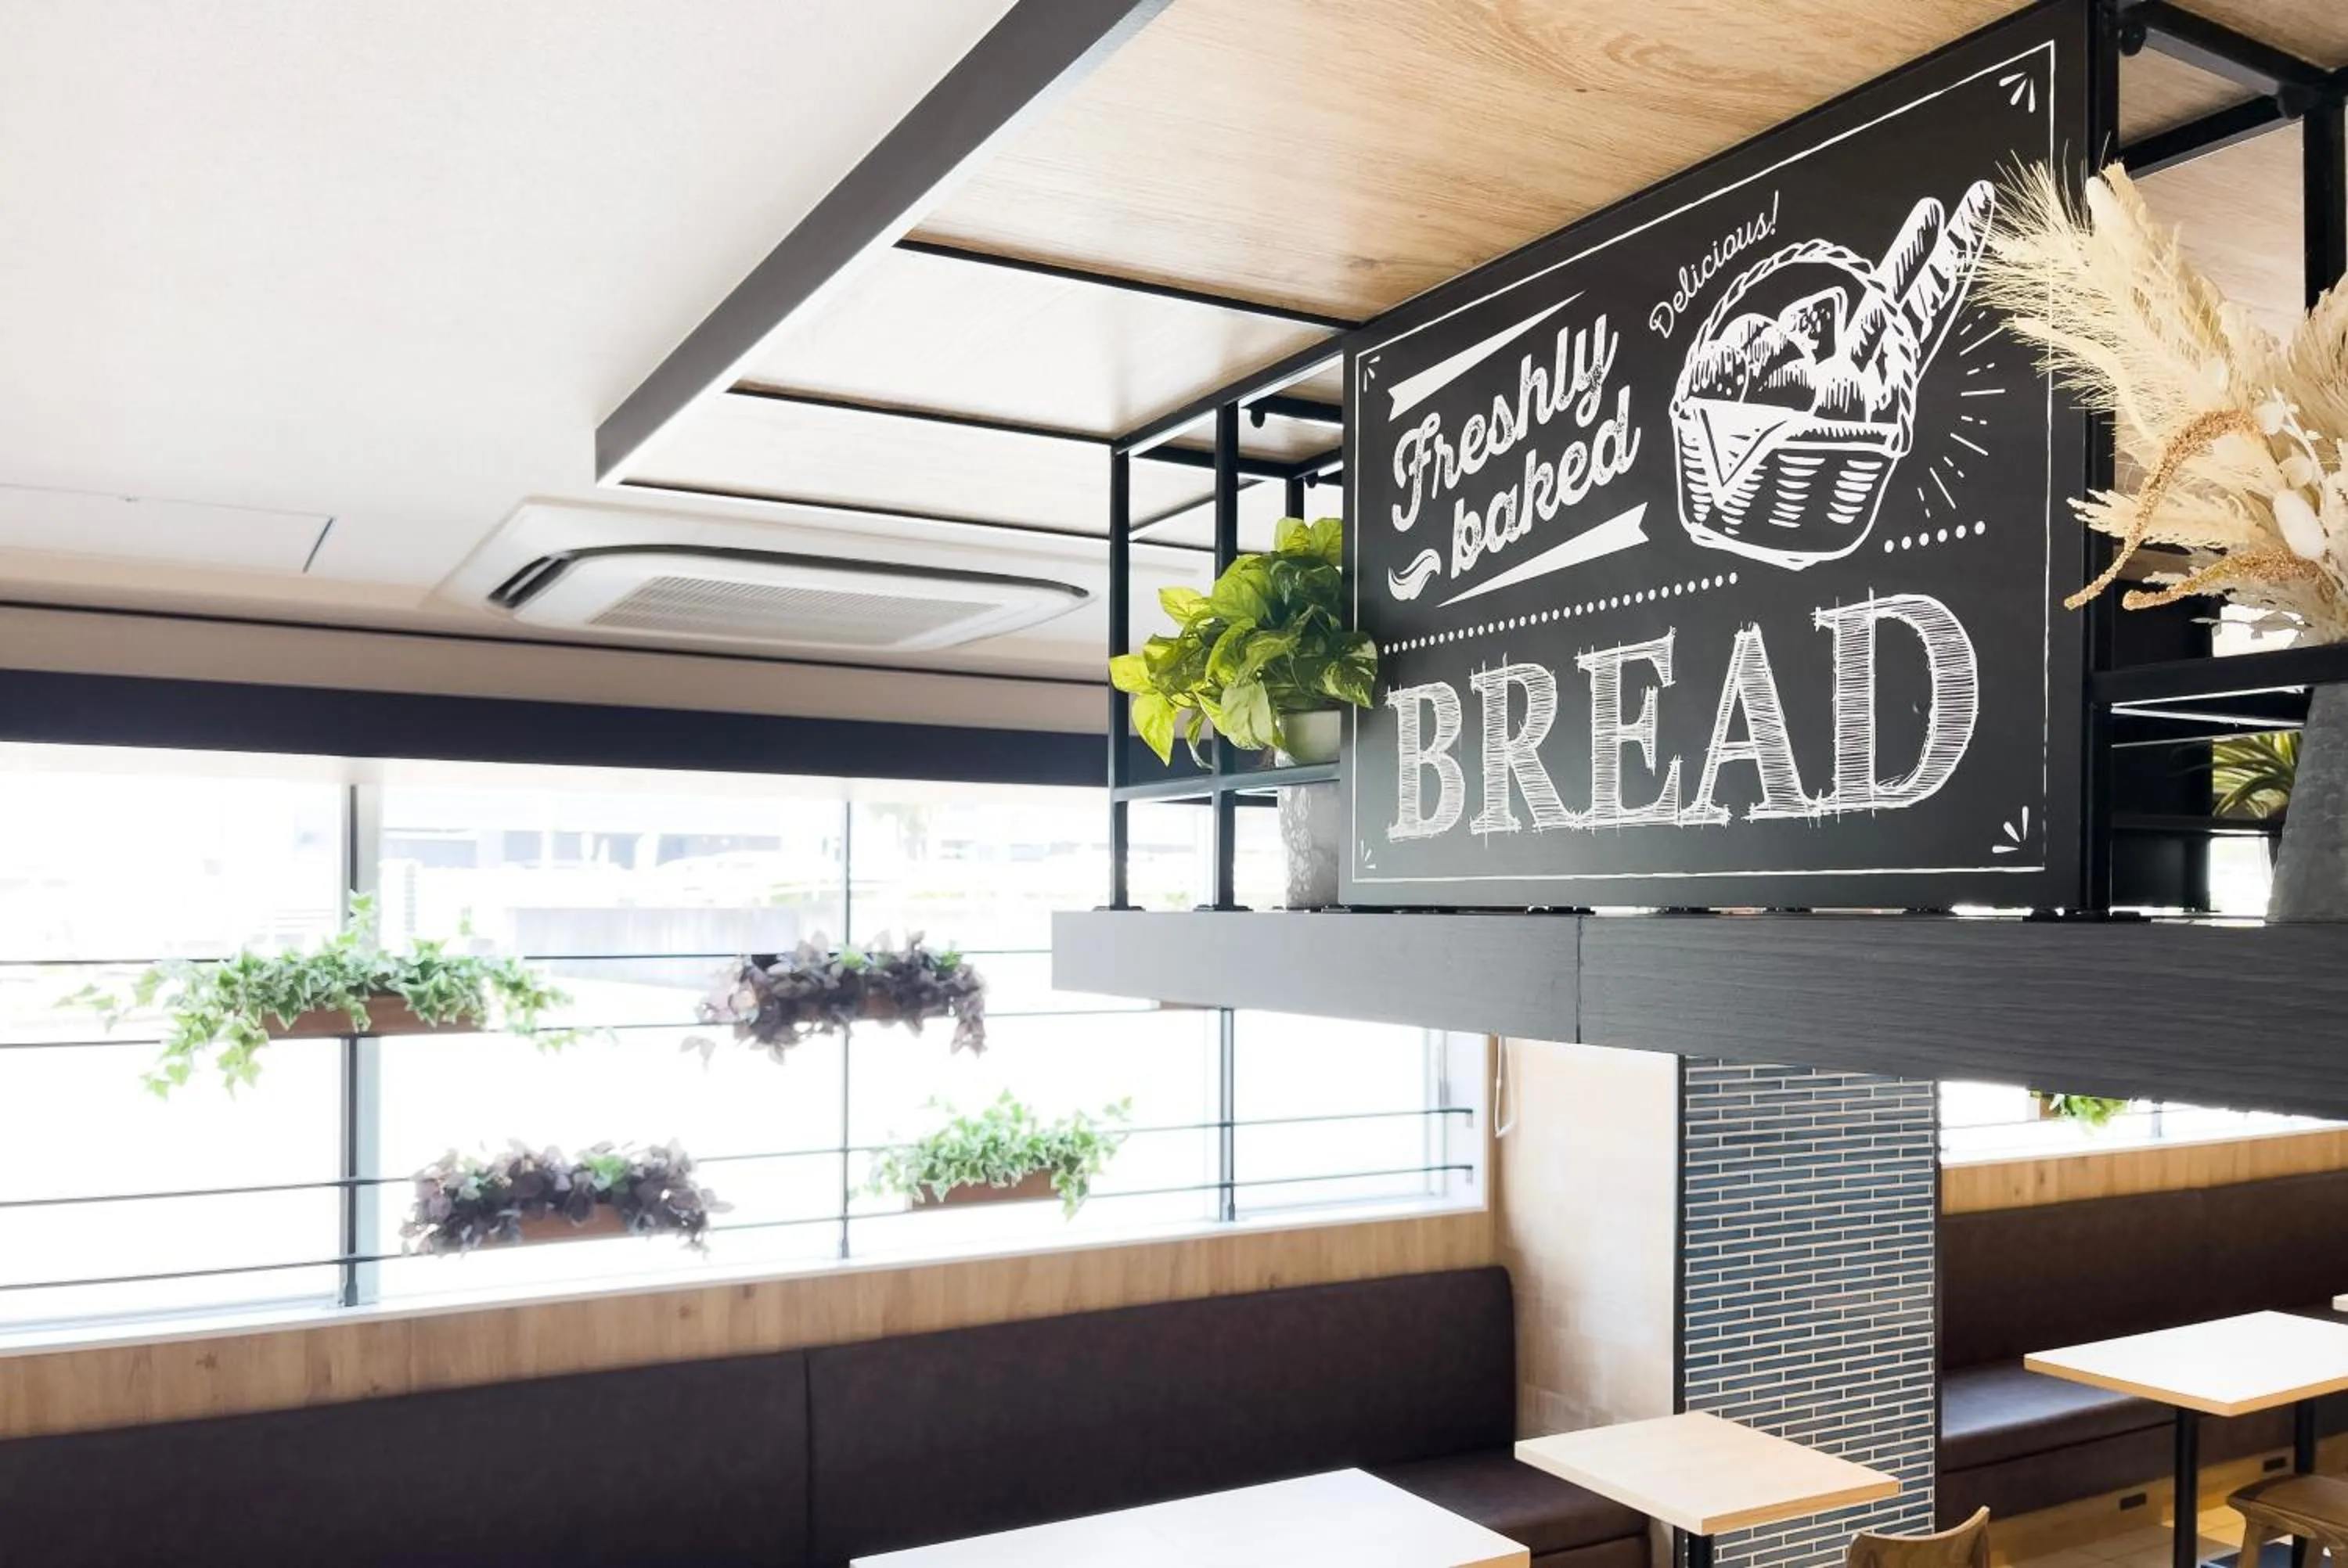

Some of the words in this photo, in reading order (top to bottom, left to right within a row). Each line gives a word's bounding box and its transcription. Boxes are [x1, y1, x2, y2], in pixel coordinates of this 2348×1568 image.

[1649, 191, 1780, 338] Delicious!
[1392, 314, 1619, 532] Freshly
[1449, 386, 1642, 580] baked
[1385, 588, 1979, 846] BREAD
